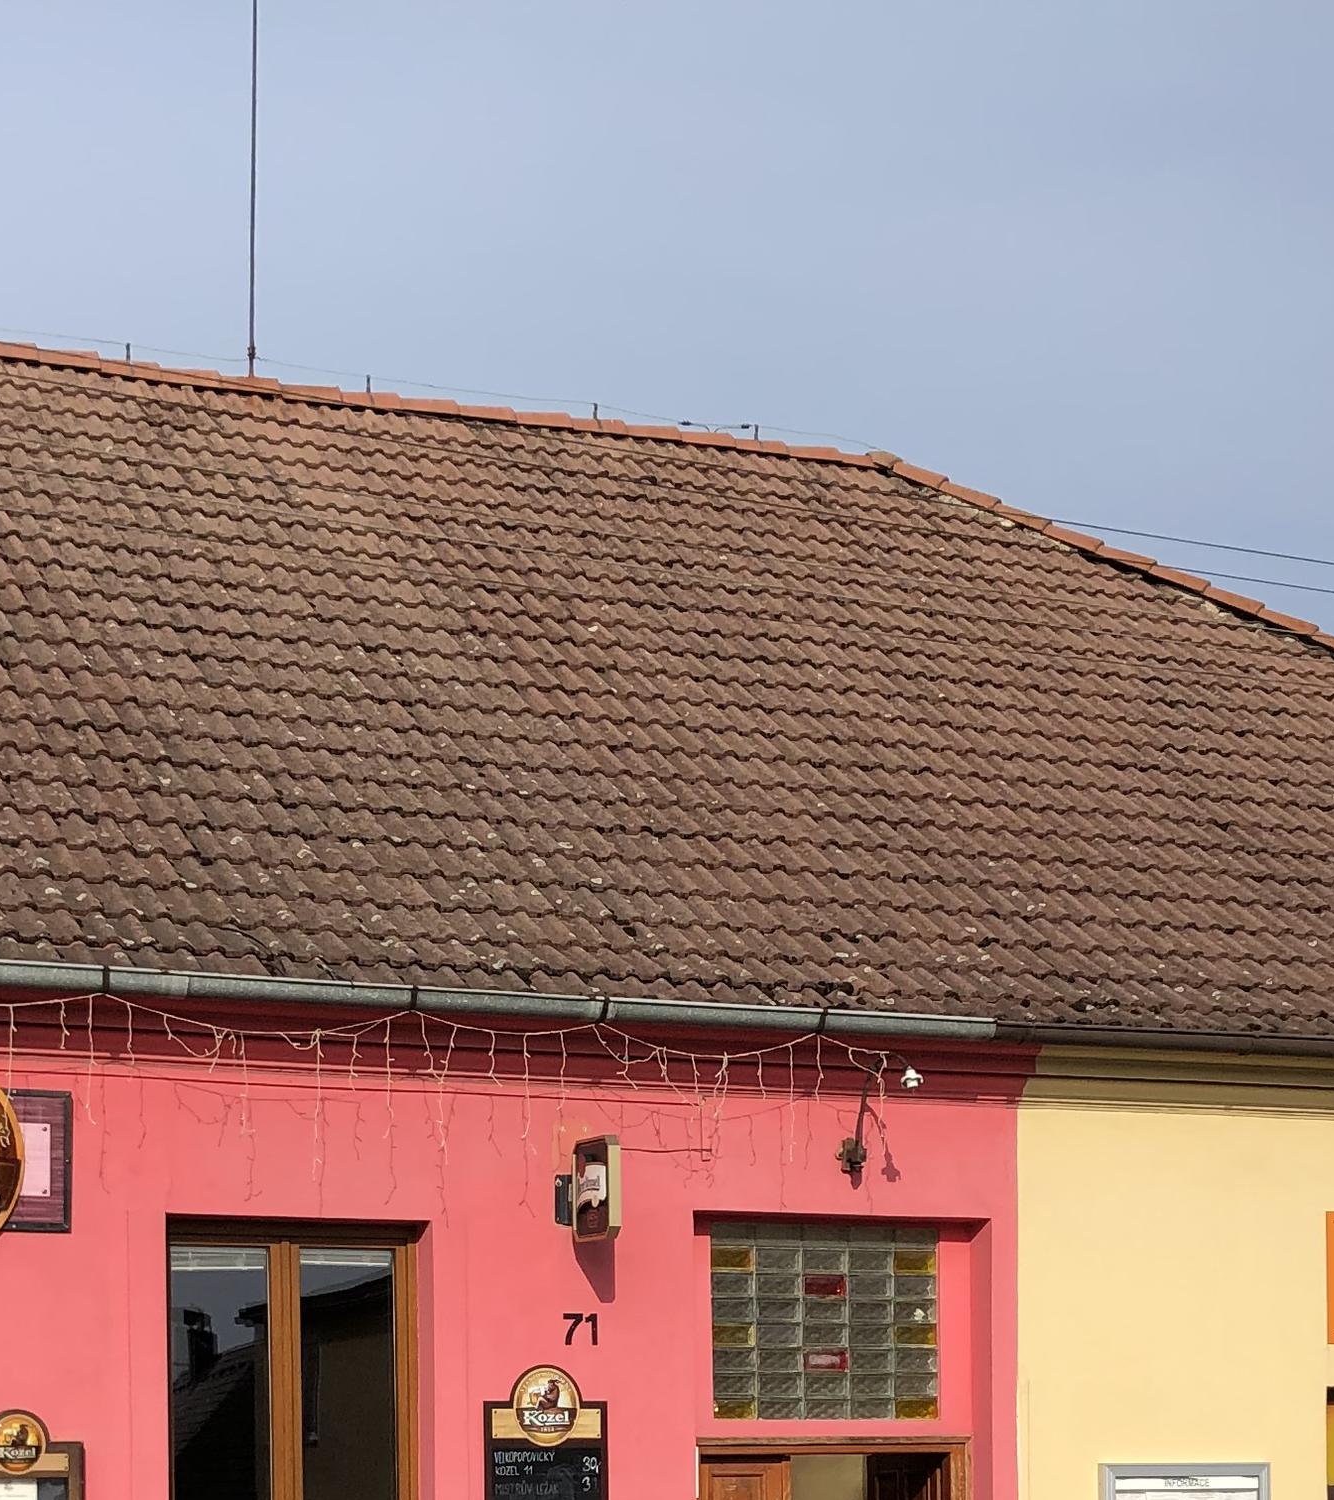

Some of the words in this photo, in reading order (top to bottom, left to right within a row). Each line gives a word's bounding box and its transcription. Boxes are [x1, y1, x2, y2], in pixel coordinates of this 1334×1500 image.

[562, 1312, 598, 1346] 71
[522, 1410, 571, 1426] Kozel
[494, 1465, 520, 1476] KOZEL
